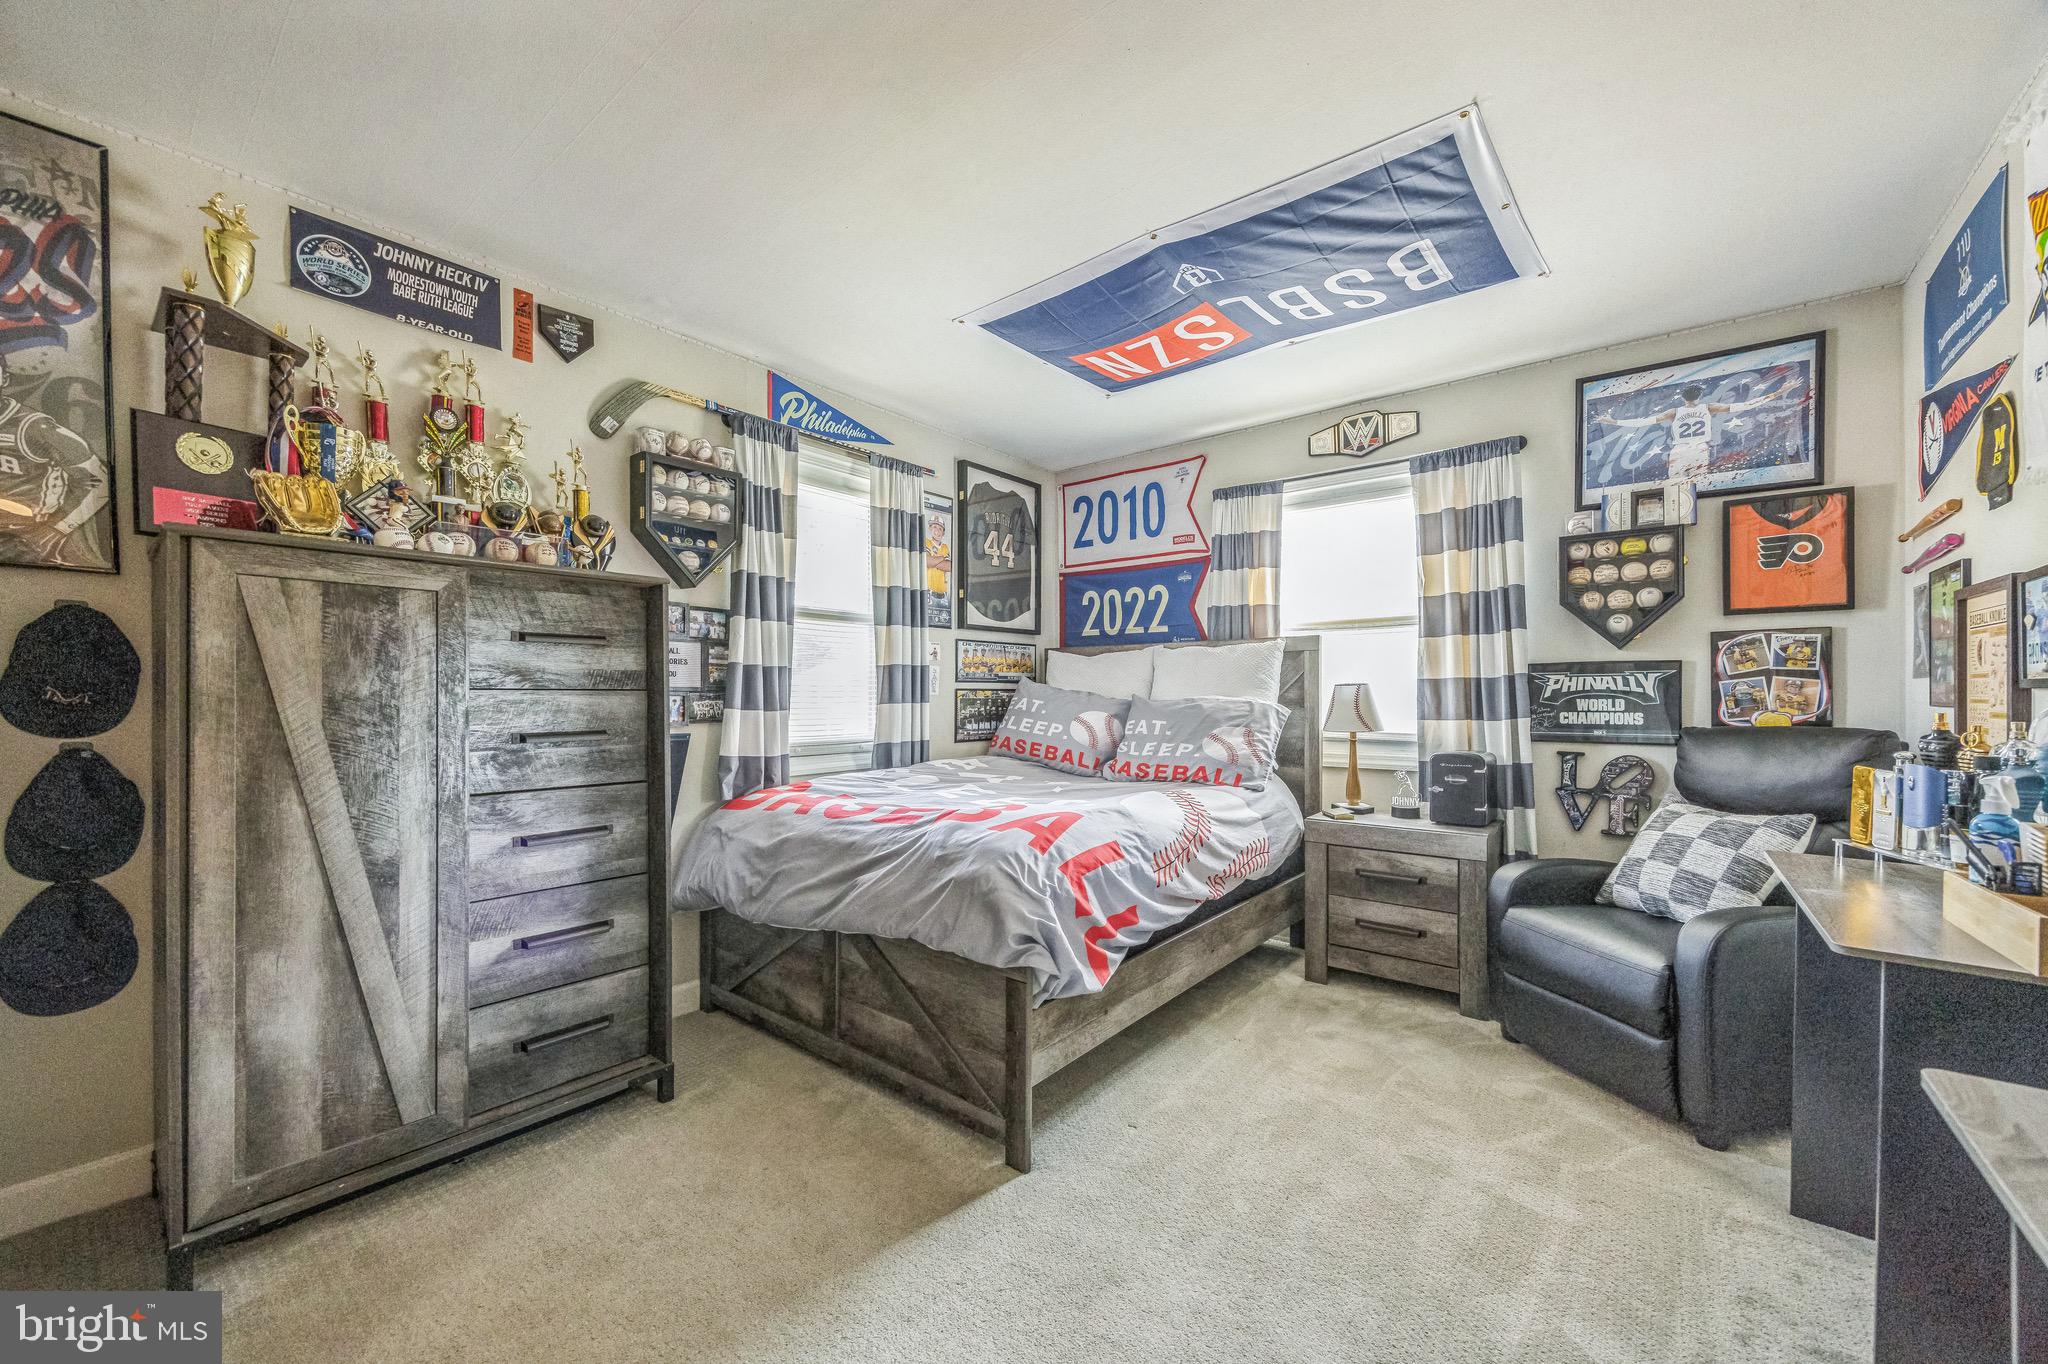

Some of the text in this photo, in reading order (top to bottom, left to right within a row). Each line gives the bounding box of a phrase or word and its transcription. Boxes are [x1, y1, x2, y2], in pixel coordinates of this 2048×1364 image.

[302, 257, 366, 282] WORLD SERIES
[373, 242, 434, 275] JOHNNY
[435, 261, 472, 286] HECK
[475, 277, 490, 292] IV
[387, 268, 479, 307] MOORESTOWN YOUTH
[393, 284, 474, 319] BABE RUTH LEAGUE
[1085, 238, 1455, 380] BSBL SZN
[396, 314, 474, 342] 8-YEAR-OLD
[780, 391, 867, 438] Philadelphia
[1942, 386, 1980, 434] VIRGINIA
[1679, 420, 1706, 439] 22
[1073, 481, 1166, 549] 2010
[984, 531, 1015, 568] 44
[1081, 585, 1169, 637] 2022
[1543, 672, 1665, 699] PHINALLY
[1559, 712, 1644, 726] CHAMPIONS
[1576, 698, 1625, 712] WORLD
[1125, 720, 1172, 735] EAT.
[1119, 741, 1200, 757] SLEEP.
[1391, 796, 1420, 806] JOHNNY
